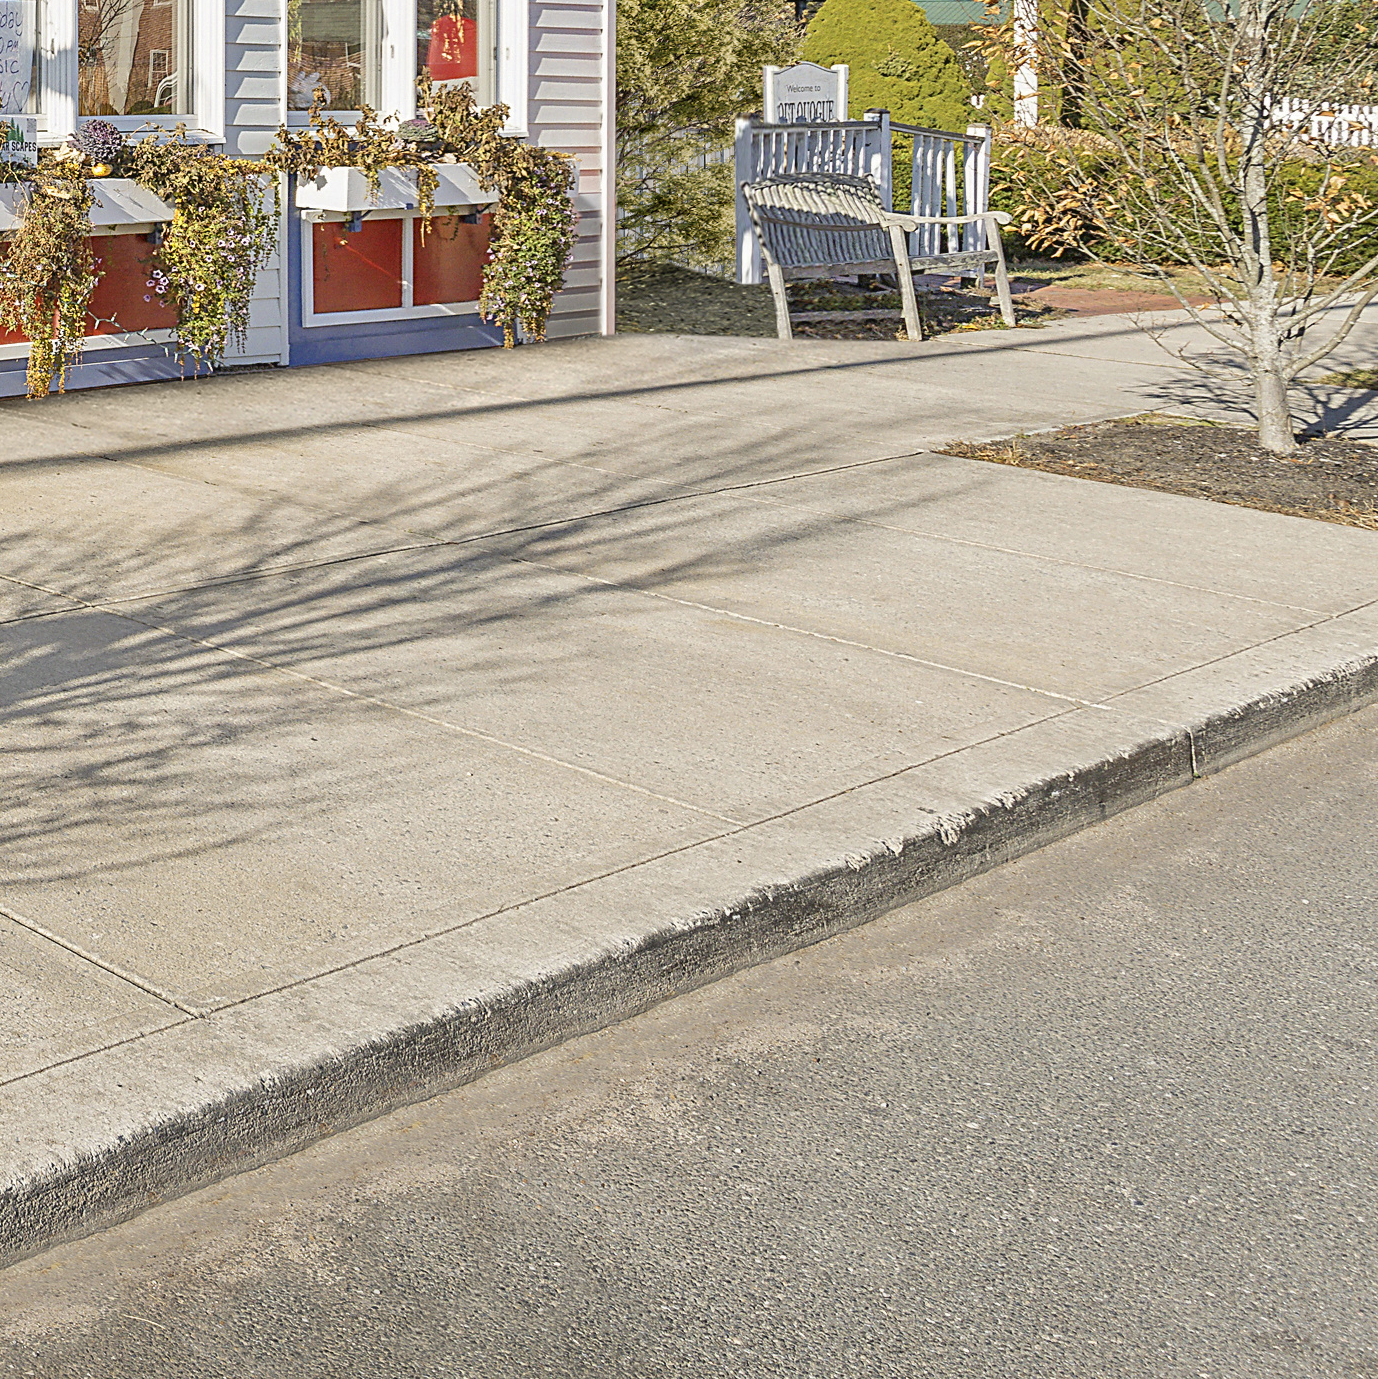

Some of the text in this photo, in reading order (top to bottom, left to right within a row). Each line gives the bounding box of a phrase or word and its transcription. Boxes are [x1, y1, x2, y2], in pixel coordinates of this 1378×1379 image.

[786, 84, 813, 93] Welcome
[797, 100, 834, 122] QUOGUE
[11, 141, 37, 152] SCAPES
